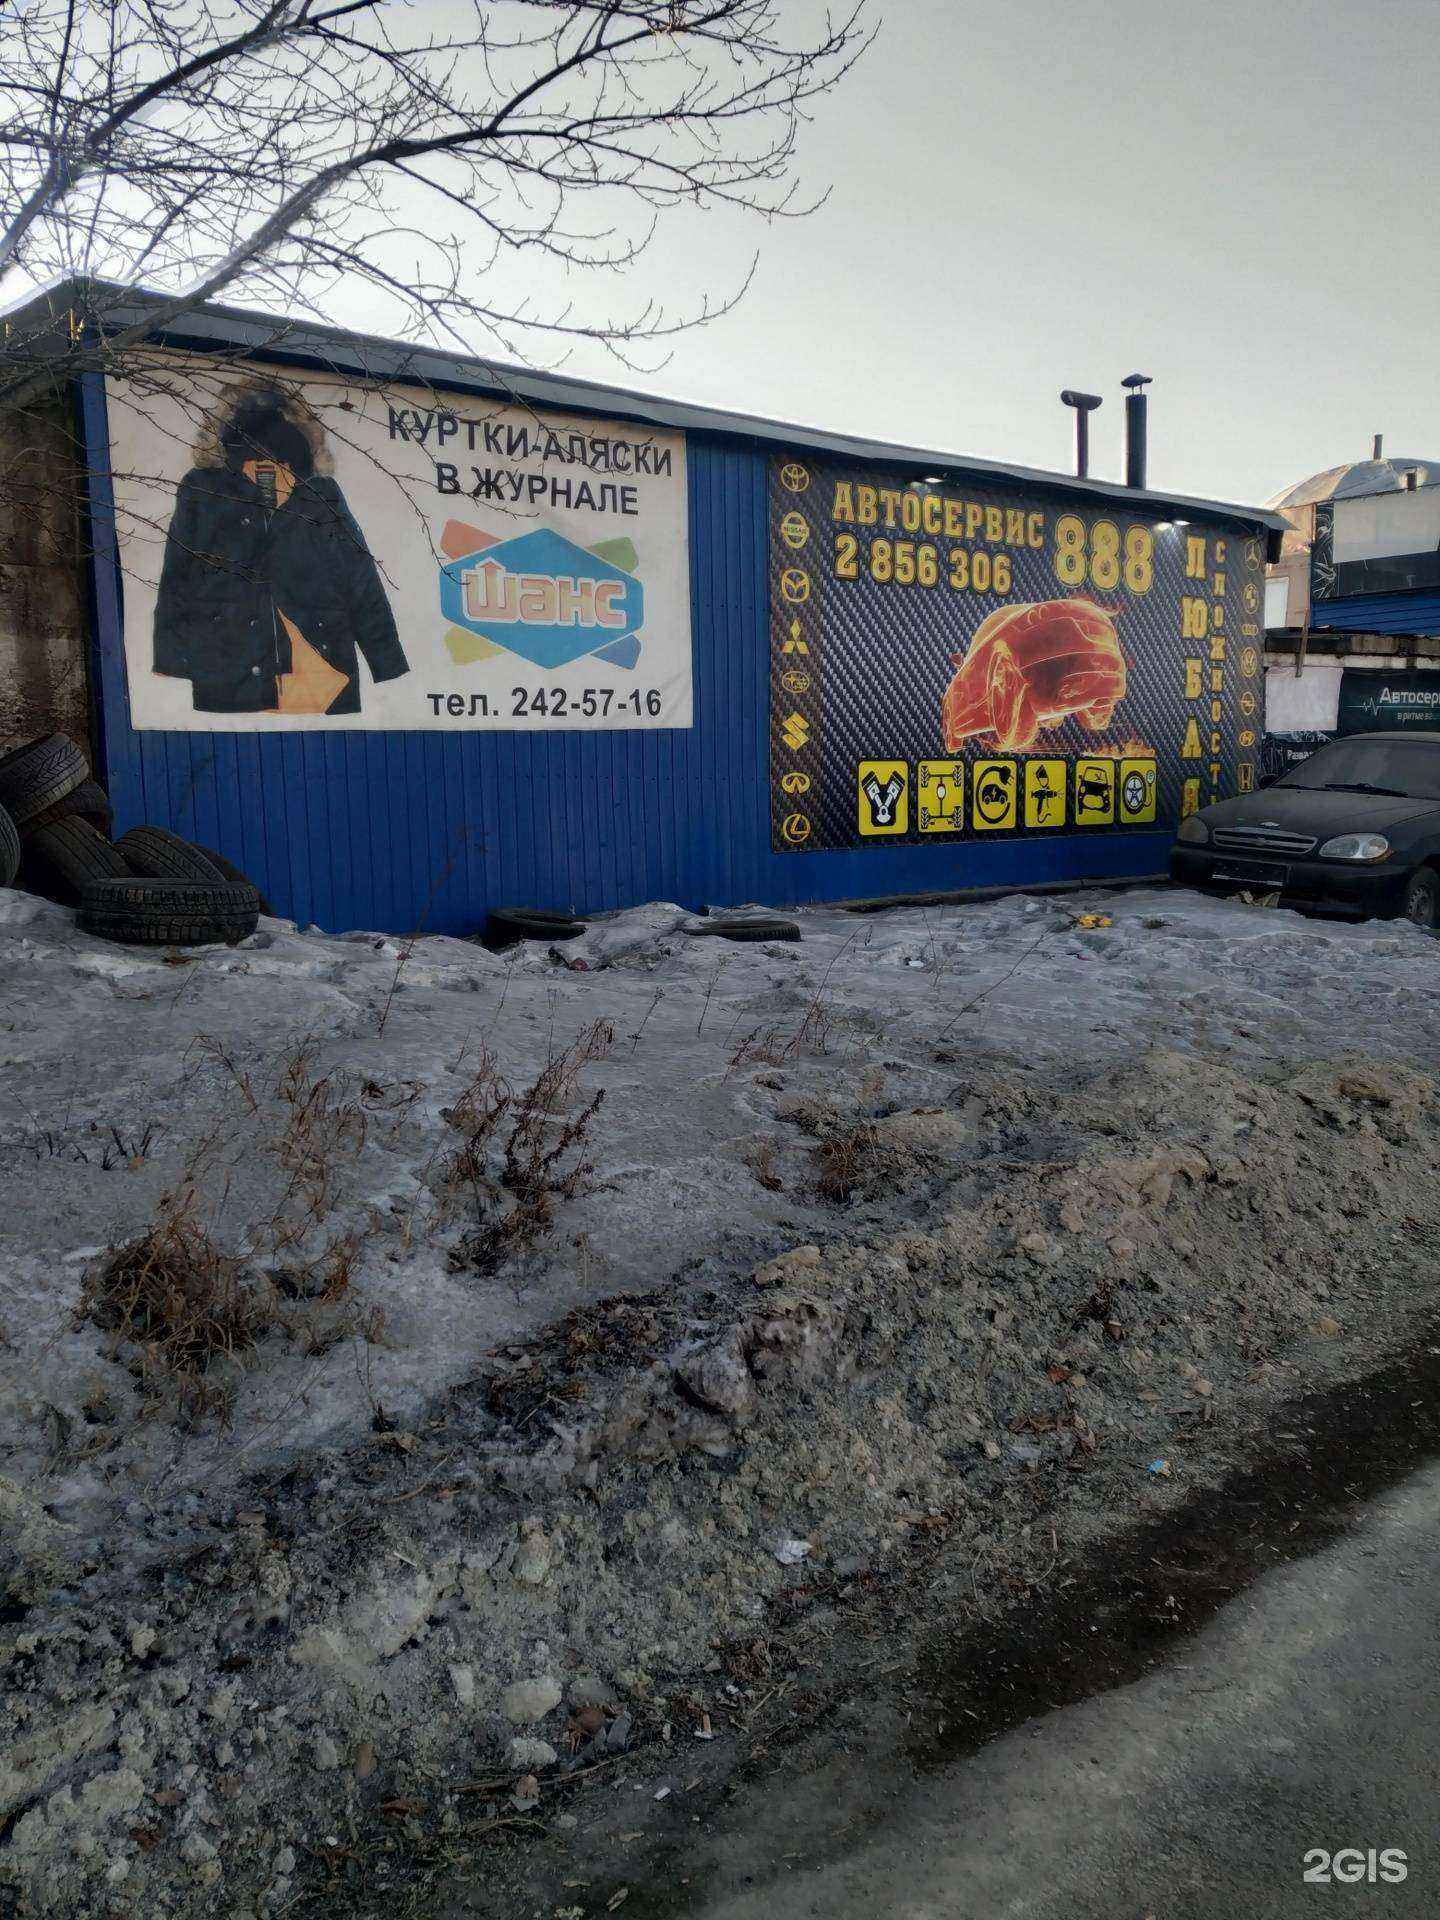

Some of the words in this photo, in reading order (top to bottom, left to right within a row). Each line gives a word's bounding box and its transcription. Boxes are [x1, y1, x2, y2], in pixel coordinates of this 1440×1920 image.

[388, 405, 672, 477] КУРТКИ-АЛЯСКИ
[436, 462, 460, 494] В
[471, 466, 639, 515] ЖУРНАЛЕ
[832, 480, 1045, 549] АВТОСЕРВИС
[1055, 514, 1155, 596] 888
[834, 532, 860, 581] 2
[870, 537, 939, 589] 856
[949, 547, 1013, 596] 306
[426, 691, 499, 717] тел.
[510, 686, 663, 718] 242-57-16
[1379, 686, 1440, 708] Автосер
